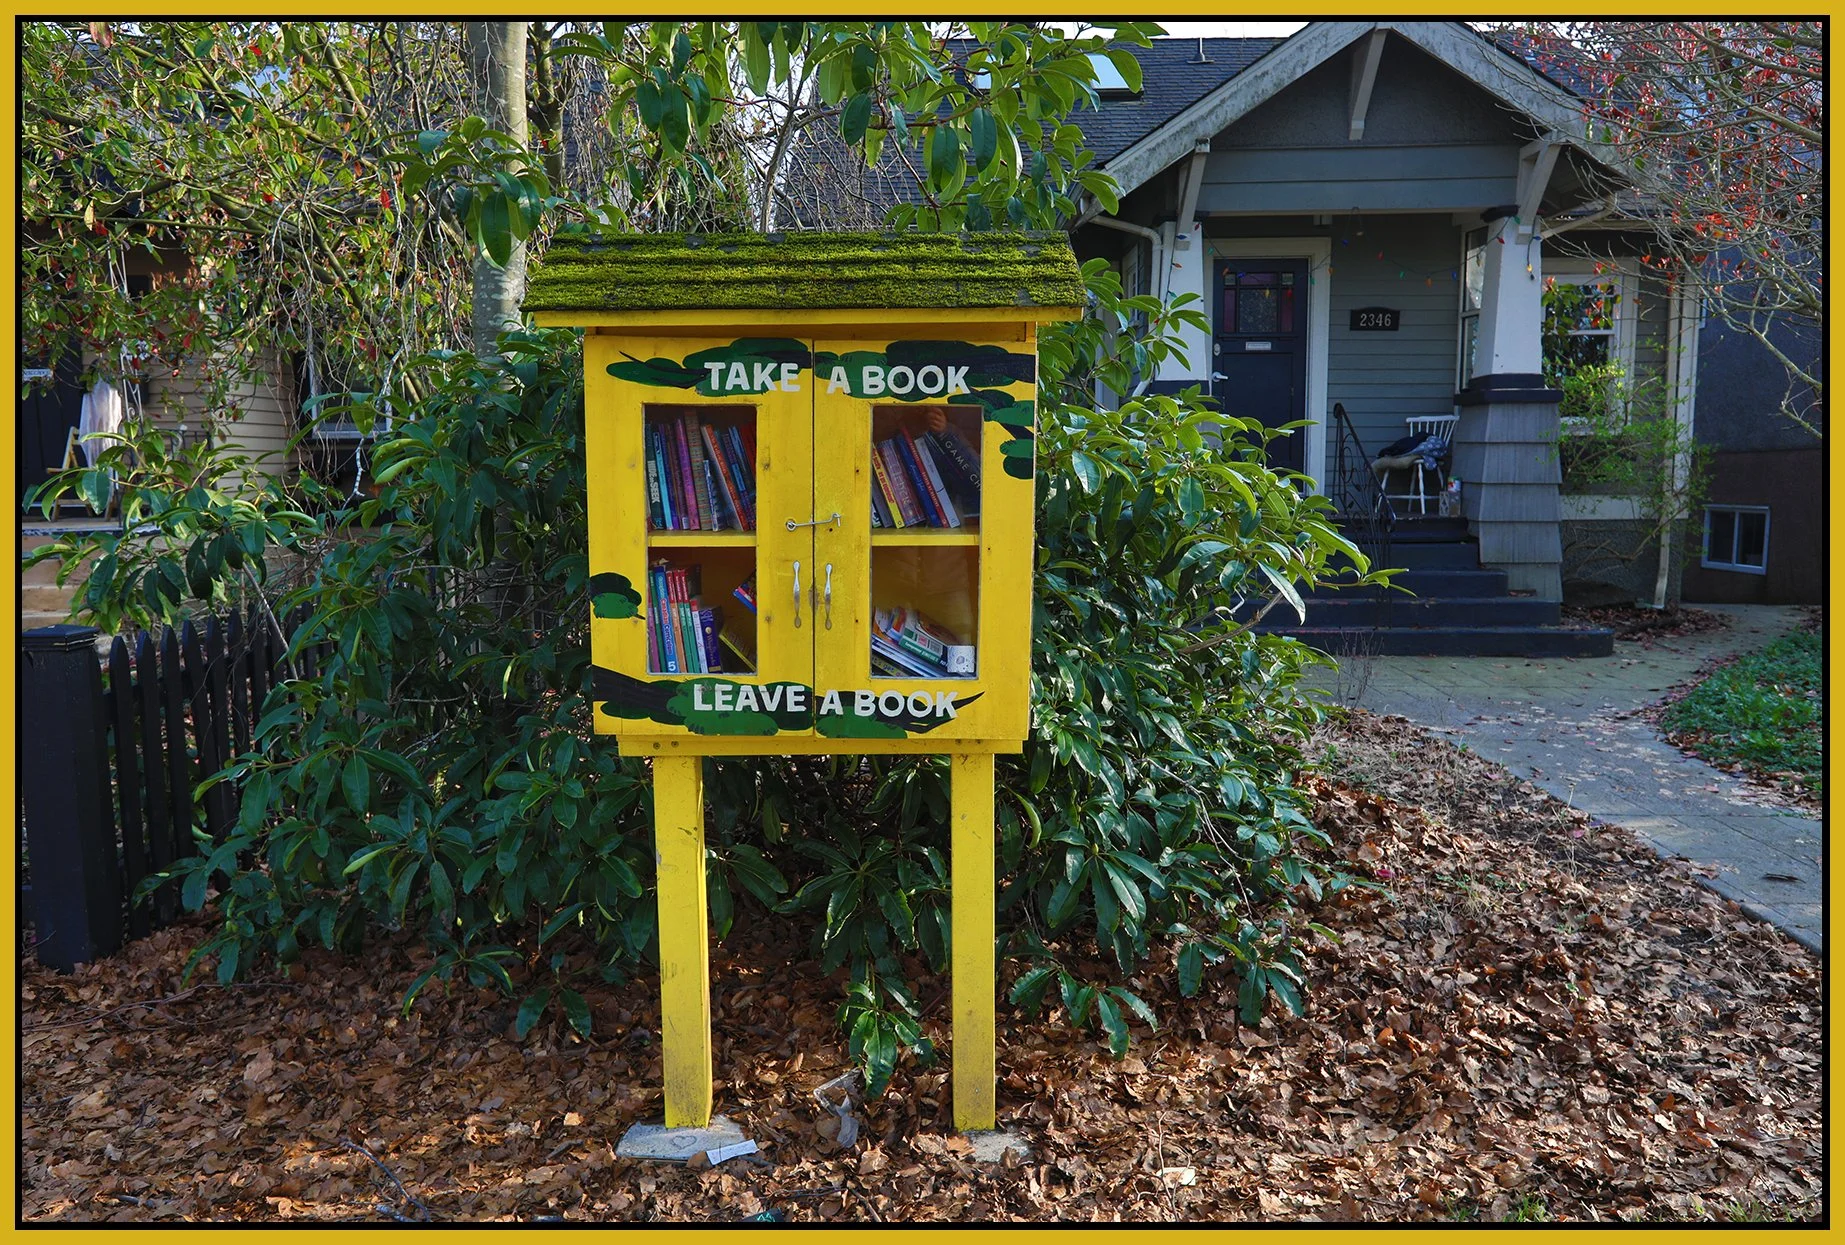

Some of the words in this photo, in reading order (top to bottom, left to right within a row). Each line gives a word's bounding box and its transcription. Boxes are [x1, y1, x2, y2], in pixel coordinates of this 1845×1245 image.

[1360, 313, 1392, 327] 2346
[704, 362, 800, 392] TAKE
[827, 365, 851, 395] A
[862, 365, 971, 395] BOOK
[945, 441, 969, 470] GAME
[647, 460, 657, 478] HIDE
[650, 481, 660, 503] SEEK
[668, 661, 676, 671] 5
[693, 684, 806, 712] LEAVE
[819, 689, 844, 716] A
[854, 690, 958, 719] BOOK
